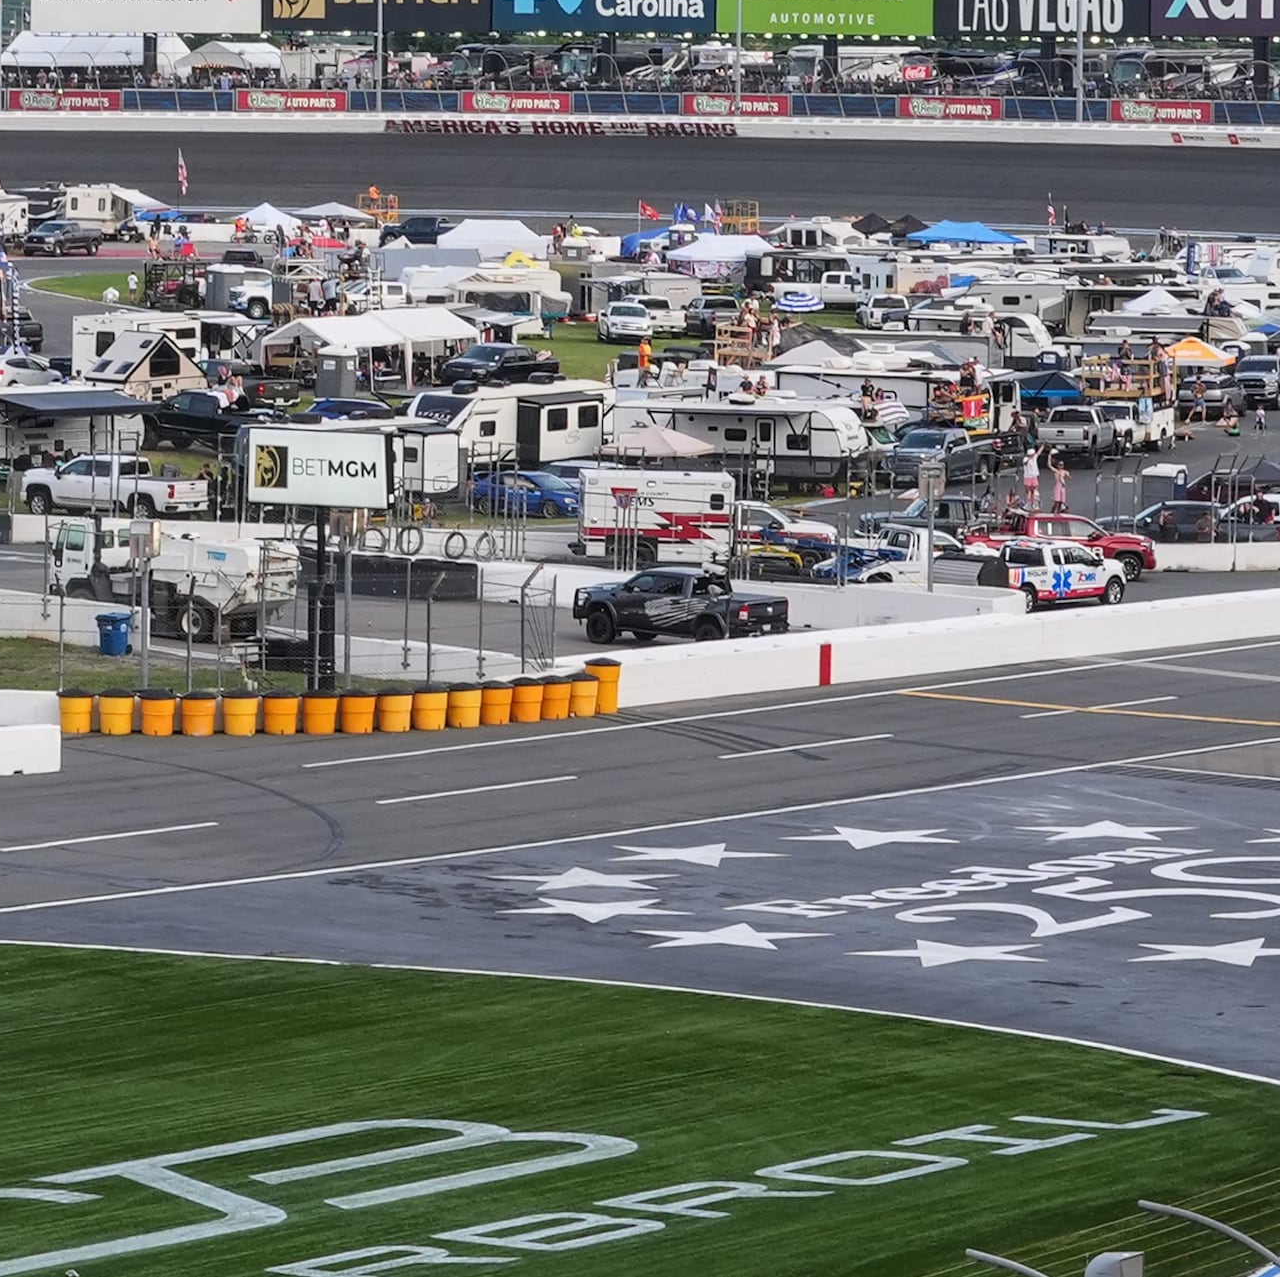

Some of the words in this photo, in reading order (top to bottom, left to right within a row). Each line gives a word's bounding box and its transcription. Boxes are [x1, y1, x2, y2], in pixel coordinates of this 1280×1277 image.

[770, 11, 875, 26] AUTOMOTIVE
[60, 97, 81, 107] AUTO
[512, 99, 533, 109] AUTO
[1157, 107, 1176, 118] AUTO
[532, 120, 605, 136] HOME
[646, 122, 738, 137] RACING
[291, 457, 378, 479] BETMGM
[723, 846, 1214, 919] Freedom
